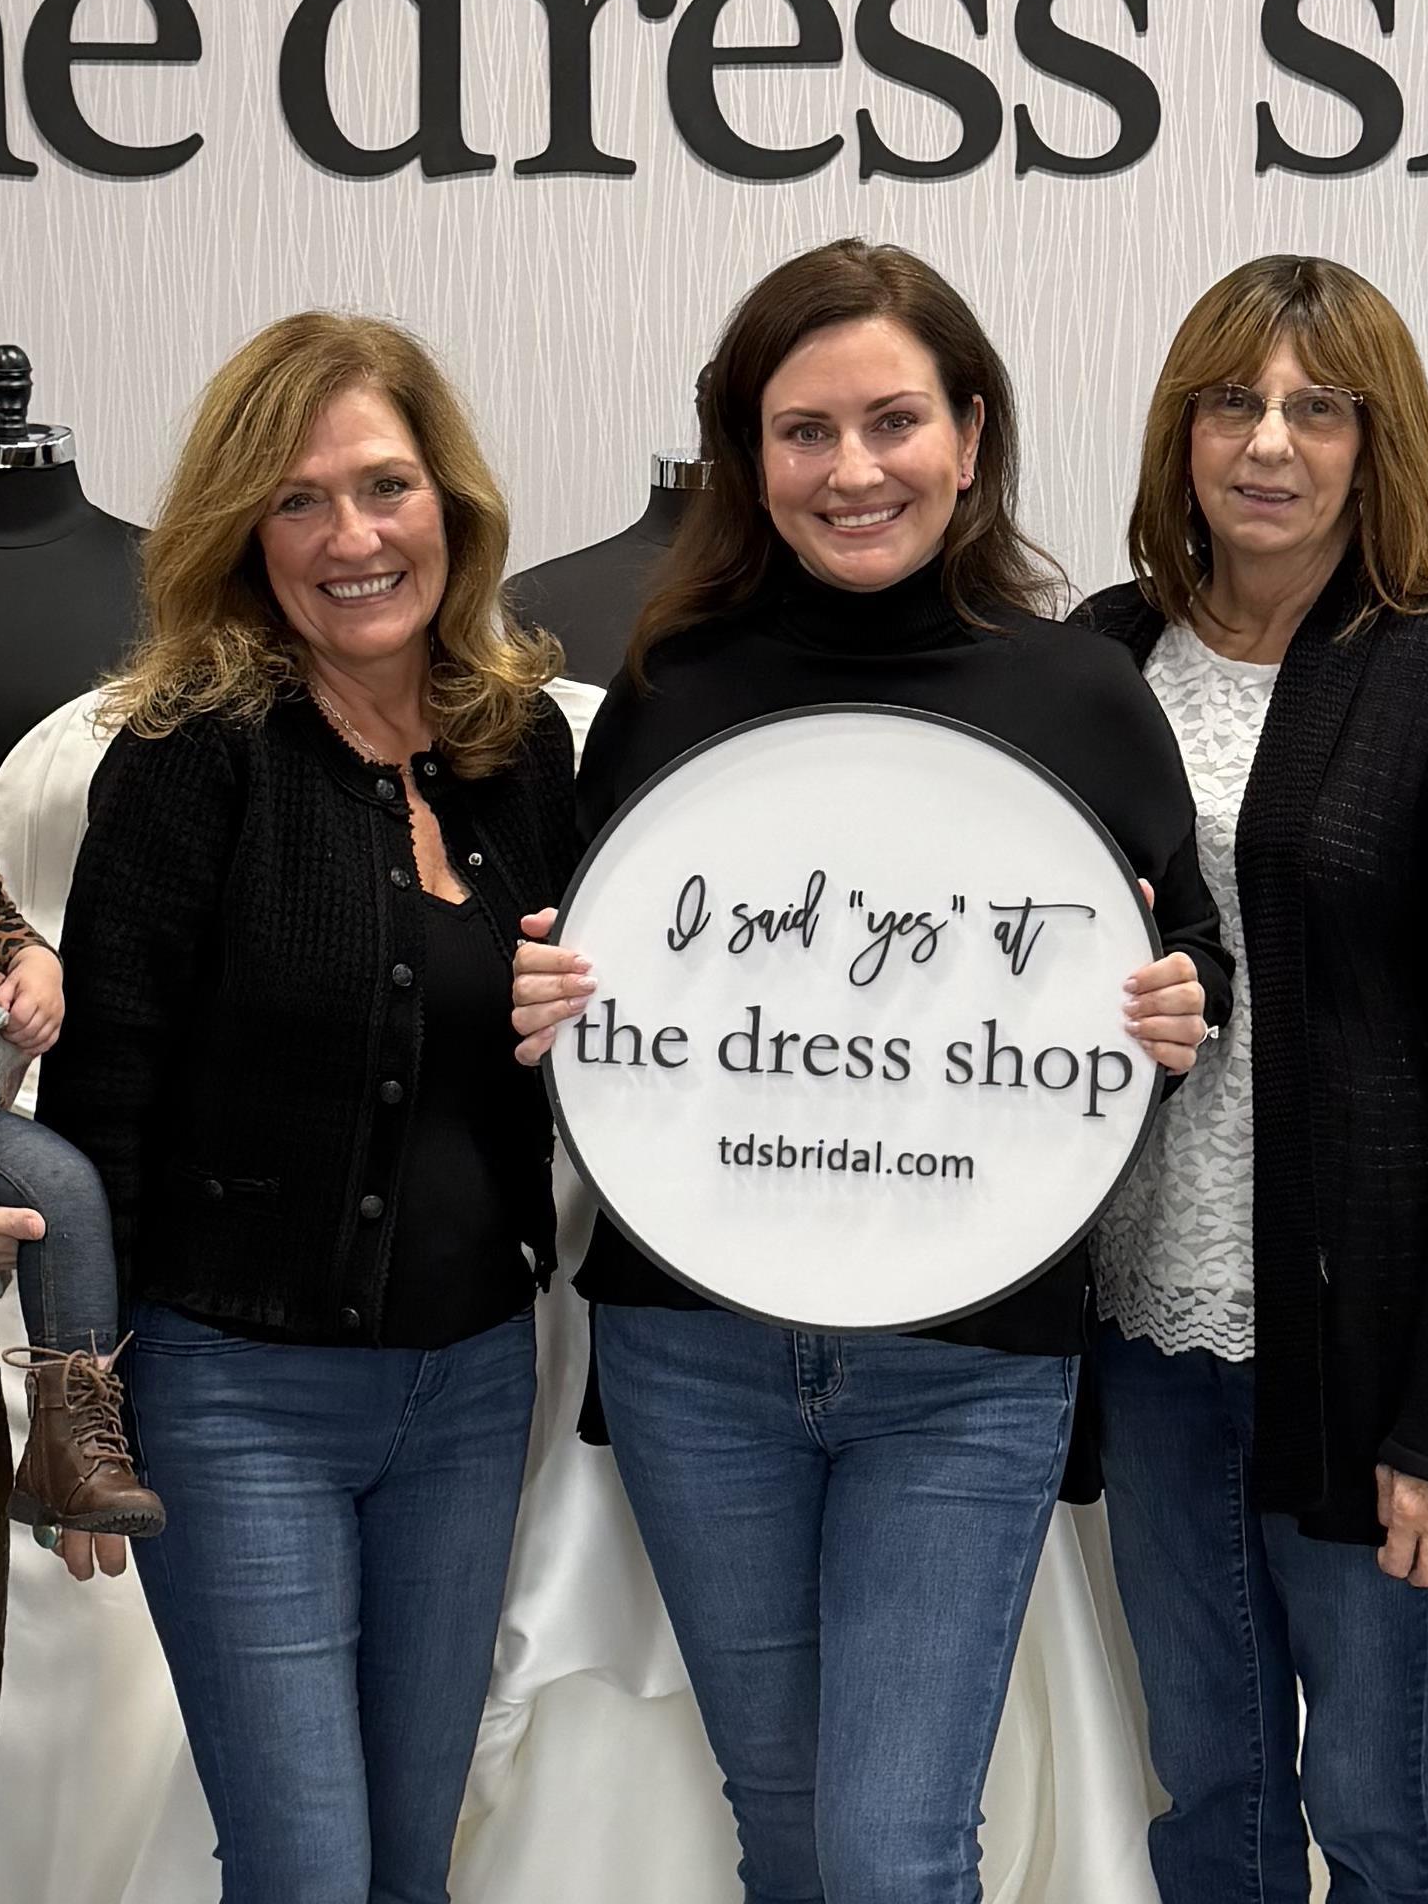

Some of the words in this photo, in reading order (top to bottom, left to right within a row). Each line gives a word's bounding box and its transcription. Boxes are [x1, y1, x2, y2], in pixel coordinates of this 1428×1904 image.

[667, 874, 712, 952] I
[727, 869, 826, 955] said
[847, 889, 966, 987] "yes"
[989, 896, 1096, 976] at
[573, 998, 690, 1069] the
[717, 1005, 912, 1082] dress
[944, 1018, 1134, 1118] shop
[717, 1132, 975, 1181] tdsbridal.com
